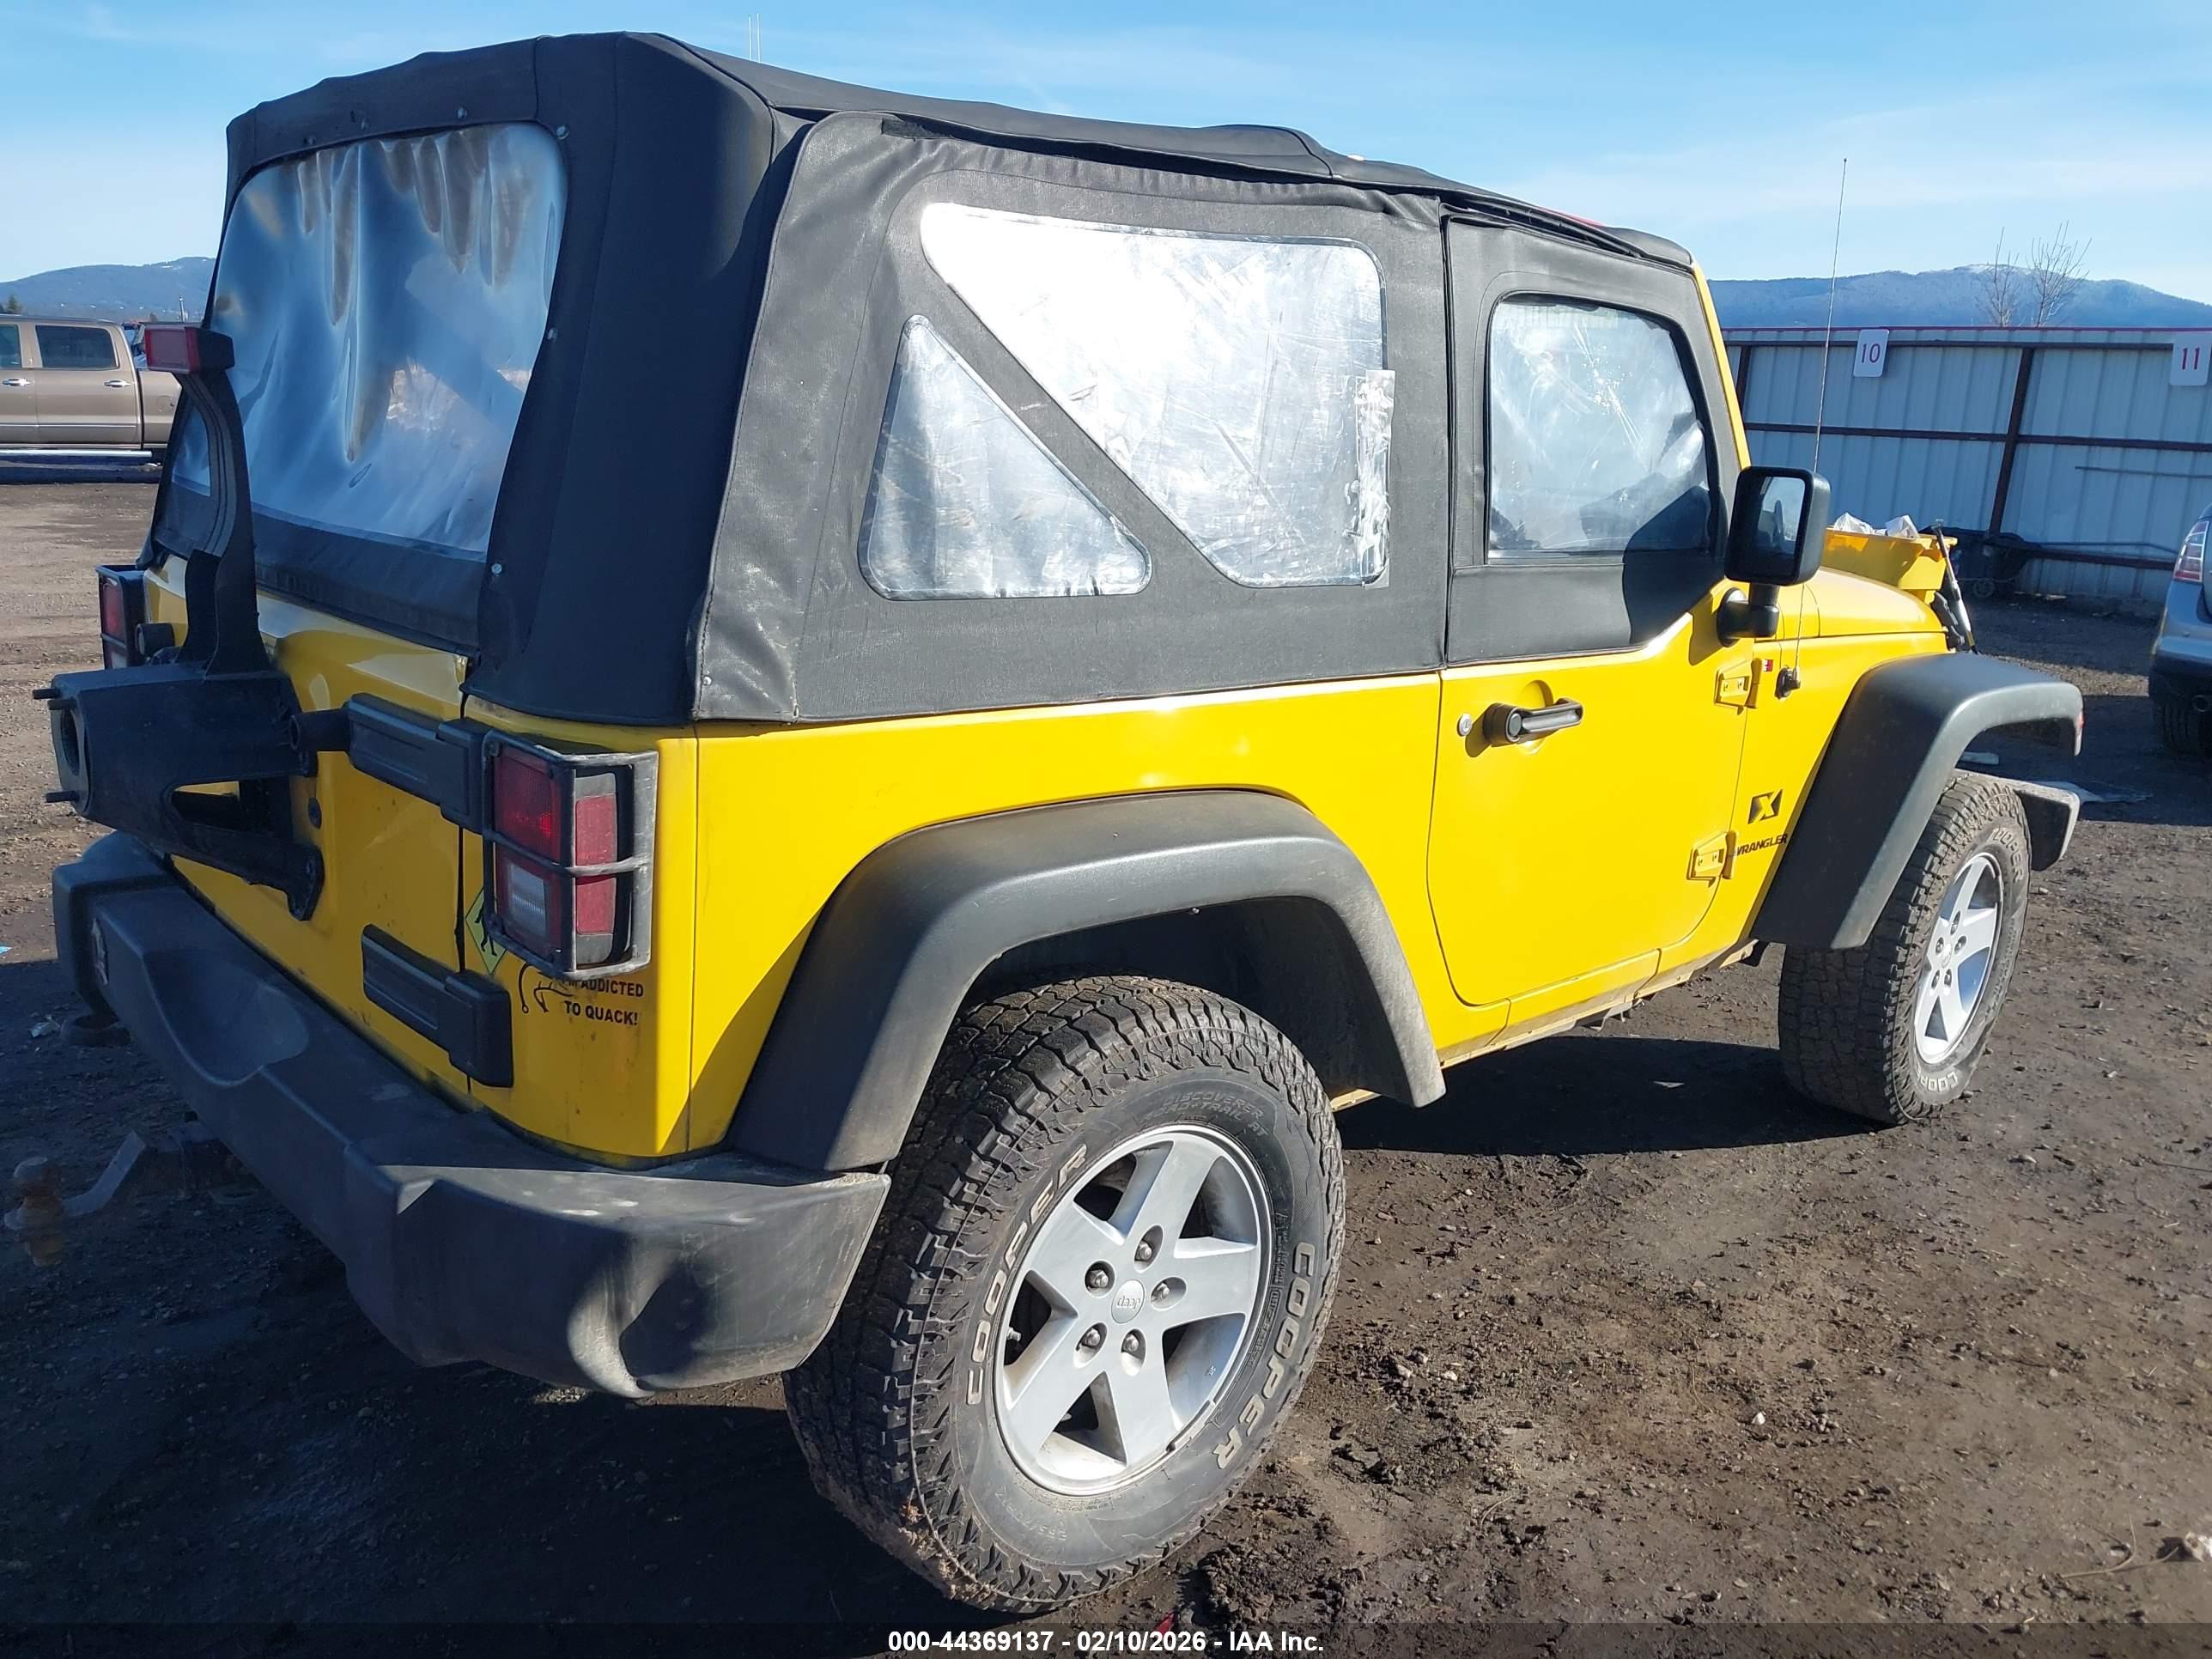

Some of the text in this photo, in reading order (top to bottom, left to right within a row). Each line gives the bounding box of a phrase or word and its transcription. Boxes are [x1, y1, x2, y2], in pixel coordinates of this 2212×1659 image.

[1861, 343, 1881, 364] 10
[2182, 347, 2200, 370] 11
[580, 979, 644, 997] ADDICTED
[564, 1000, 637, 1025] TO QUACK!
[966, 1143, 1088, 1406] COOPER
[1212, 1241, 1316, 1470] COOPER
